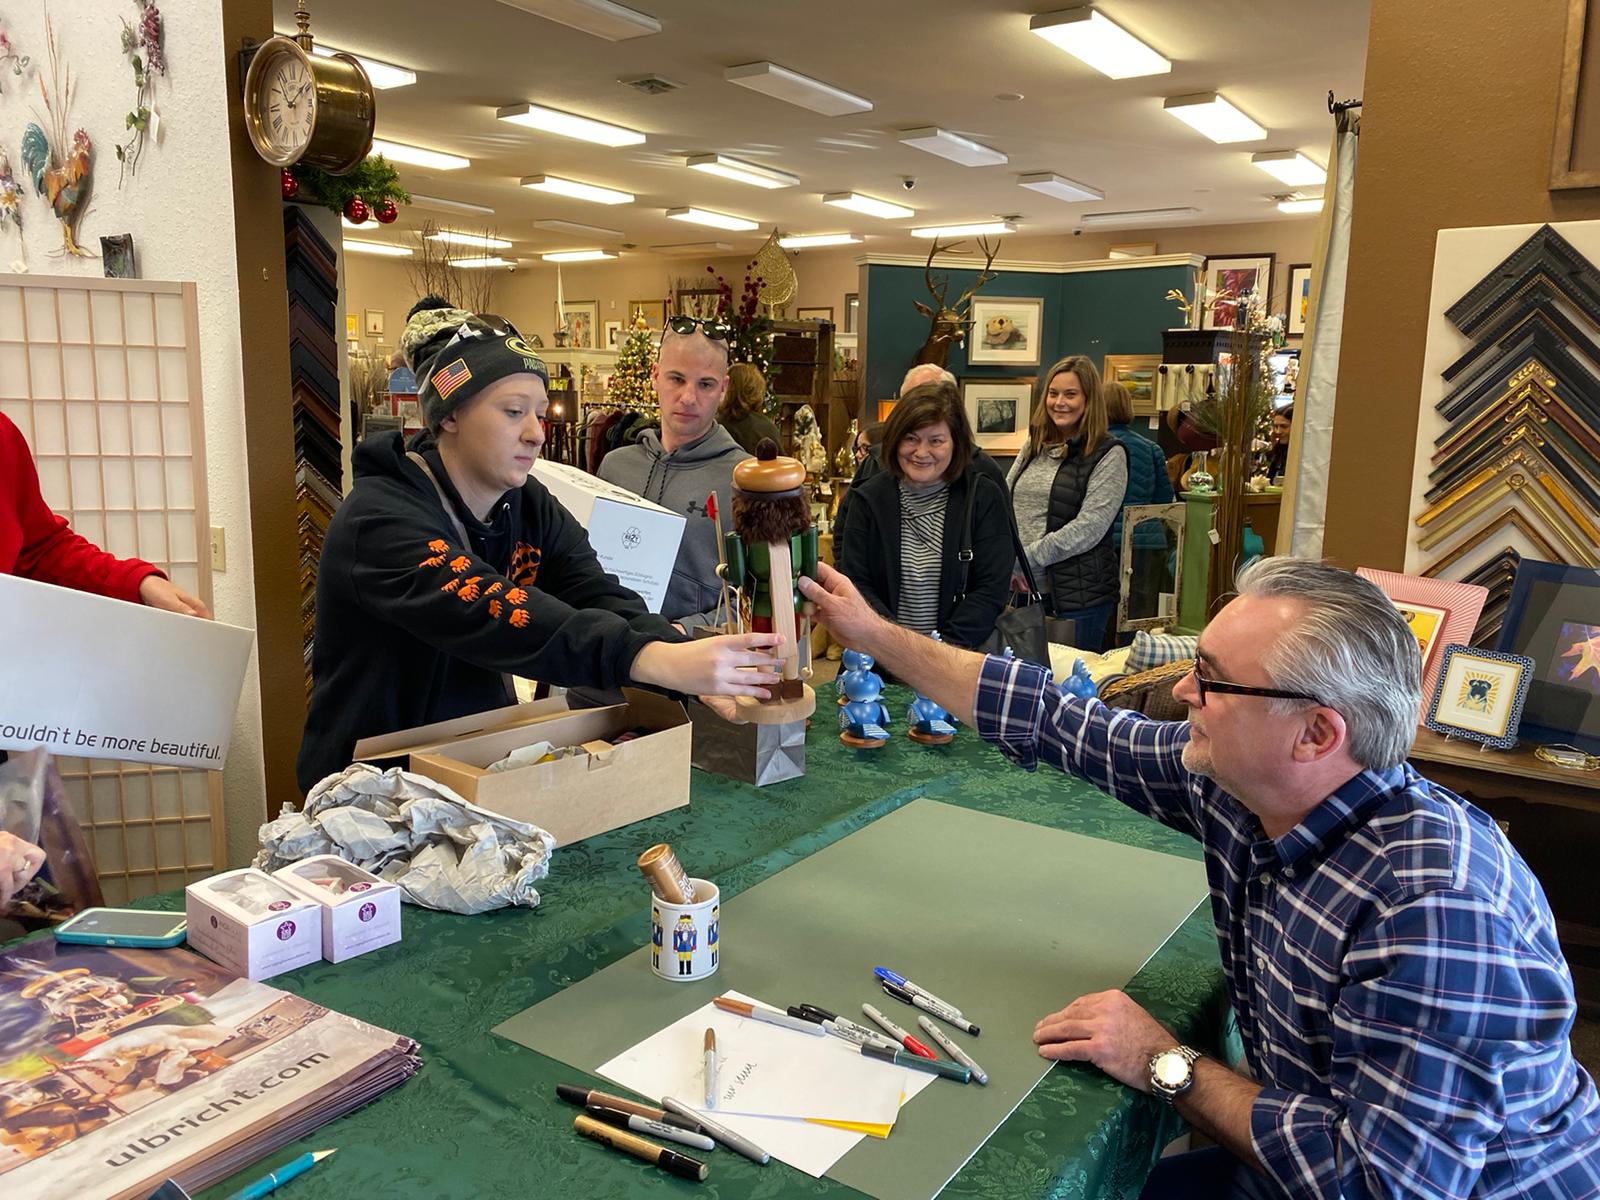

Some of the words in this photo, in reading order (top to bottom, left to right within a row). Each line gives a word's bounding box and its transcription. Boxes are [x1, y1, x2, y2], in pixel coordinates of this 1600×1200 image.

[75, 730, 97, 747] be
[101, 736, 146, 752] more
[150, 738, 221, 760] beautiful.
[105, 1052, 330, 1168] ulbricht.com
